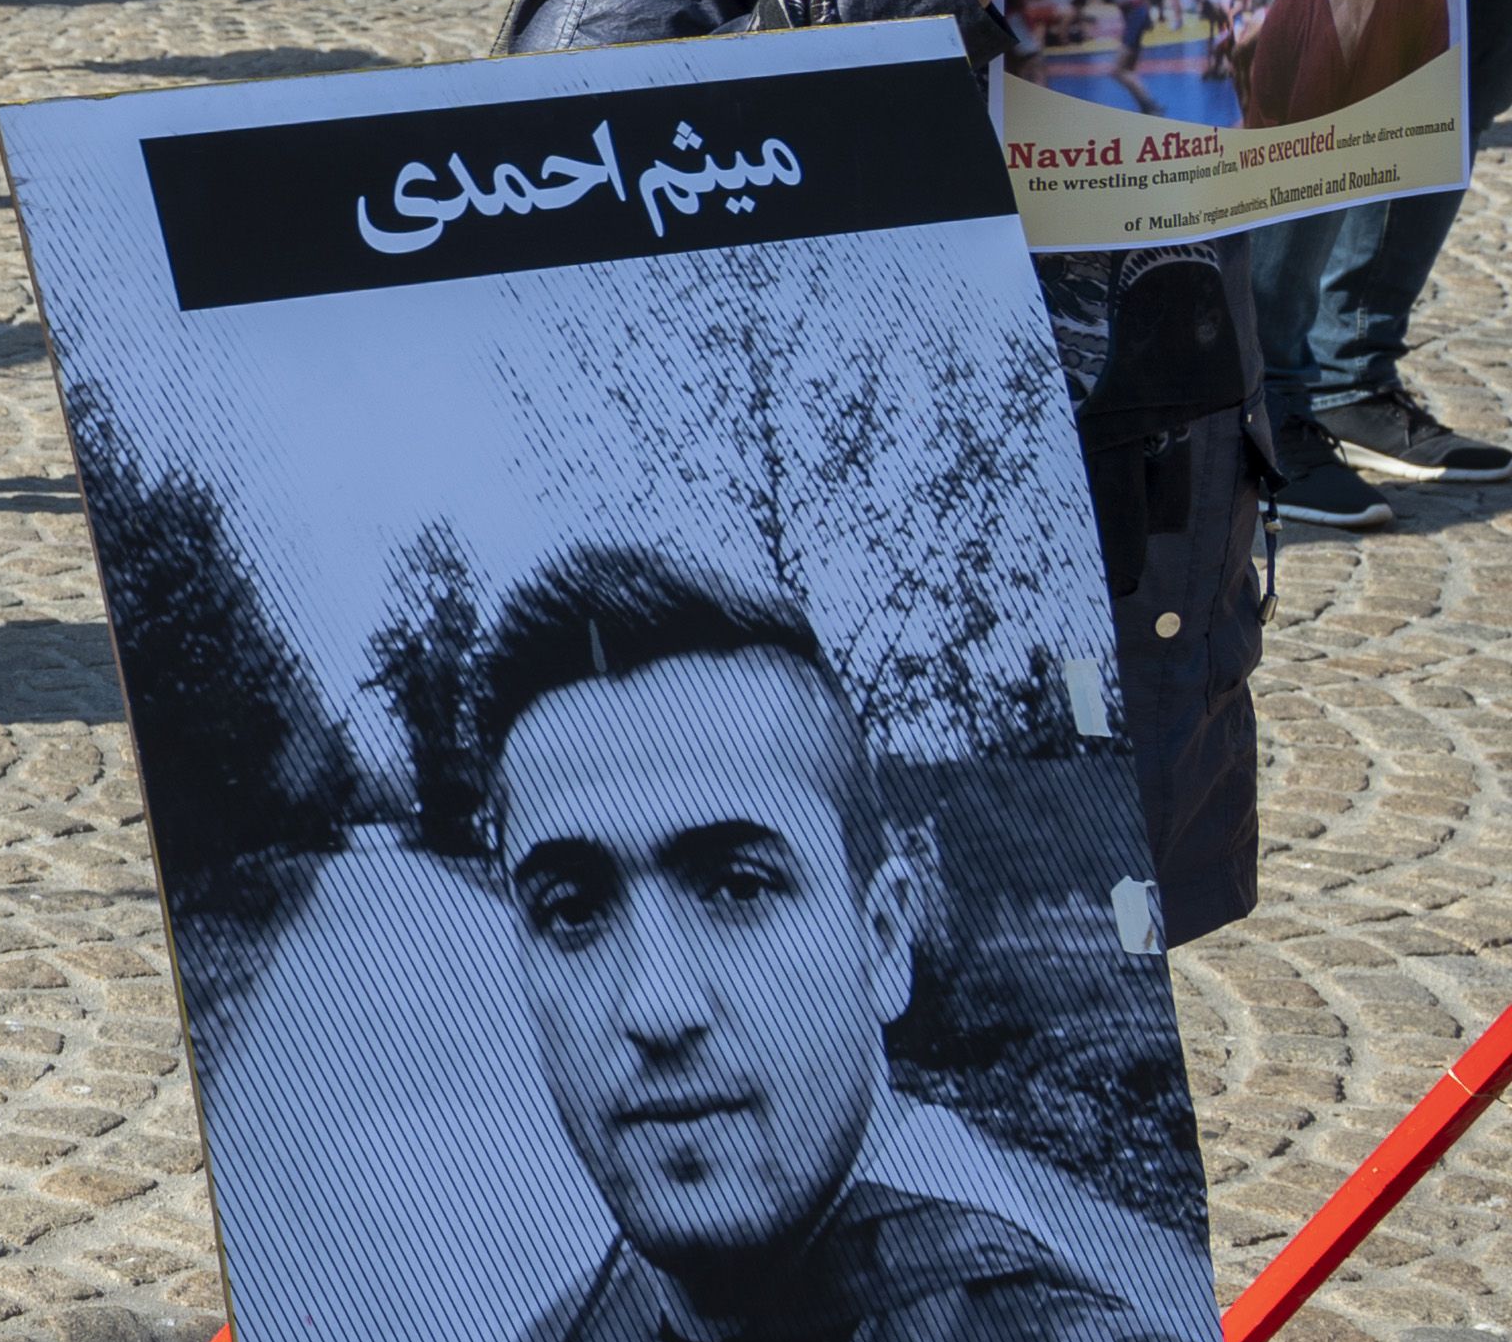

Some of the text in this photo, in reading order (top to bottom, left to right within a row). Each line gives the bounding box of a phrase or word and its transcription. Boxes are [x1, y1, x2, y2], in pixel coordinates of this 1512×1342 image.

[1007, 117, 1455, 170] Navid Afkari, was executed under the direct command
[355, 118, 802, 256] میثم احمدی
[1028, 160, 1239, 192] the wrestling champion of Iran,
[1124, 217, 1142, 232] of
[1203, 205, 1229, 223] regime
[1269, 179, 1324, 208] Khamenei
[1325, 173, 1347, 195] and
[1348, 163, 1401, 192] Rouhani.
